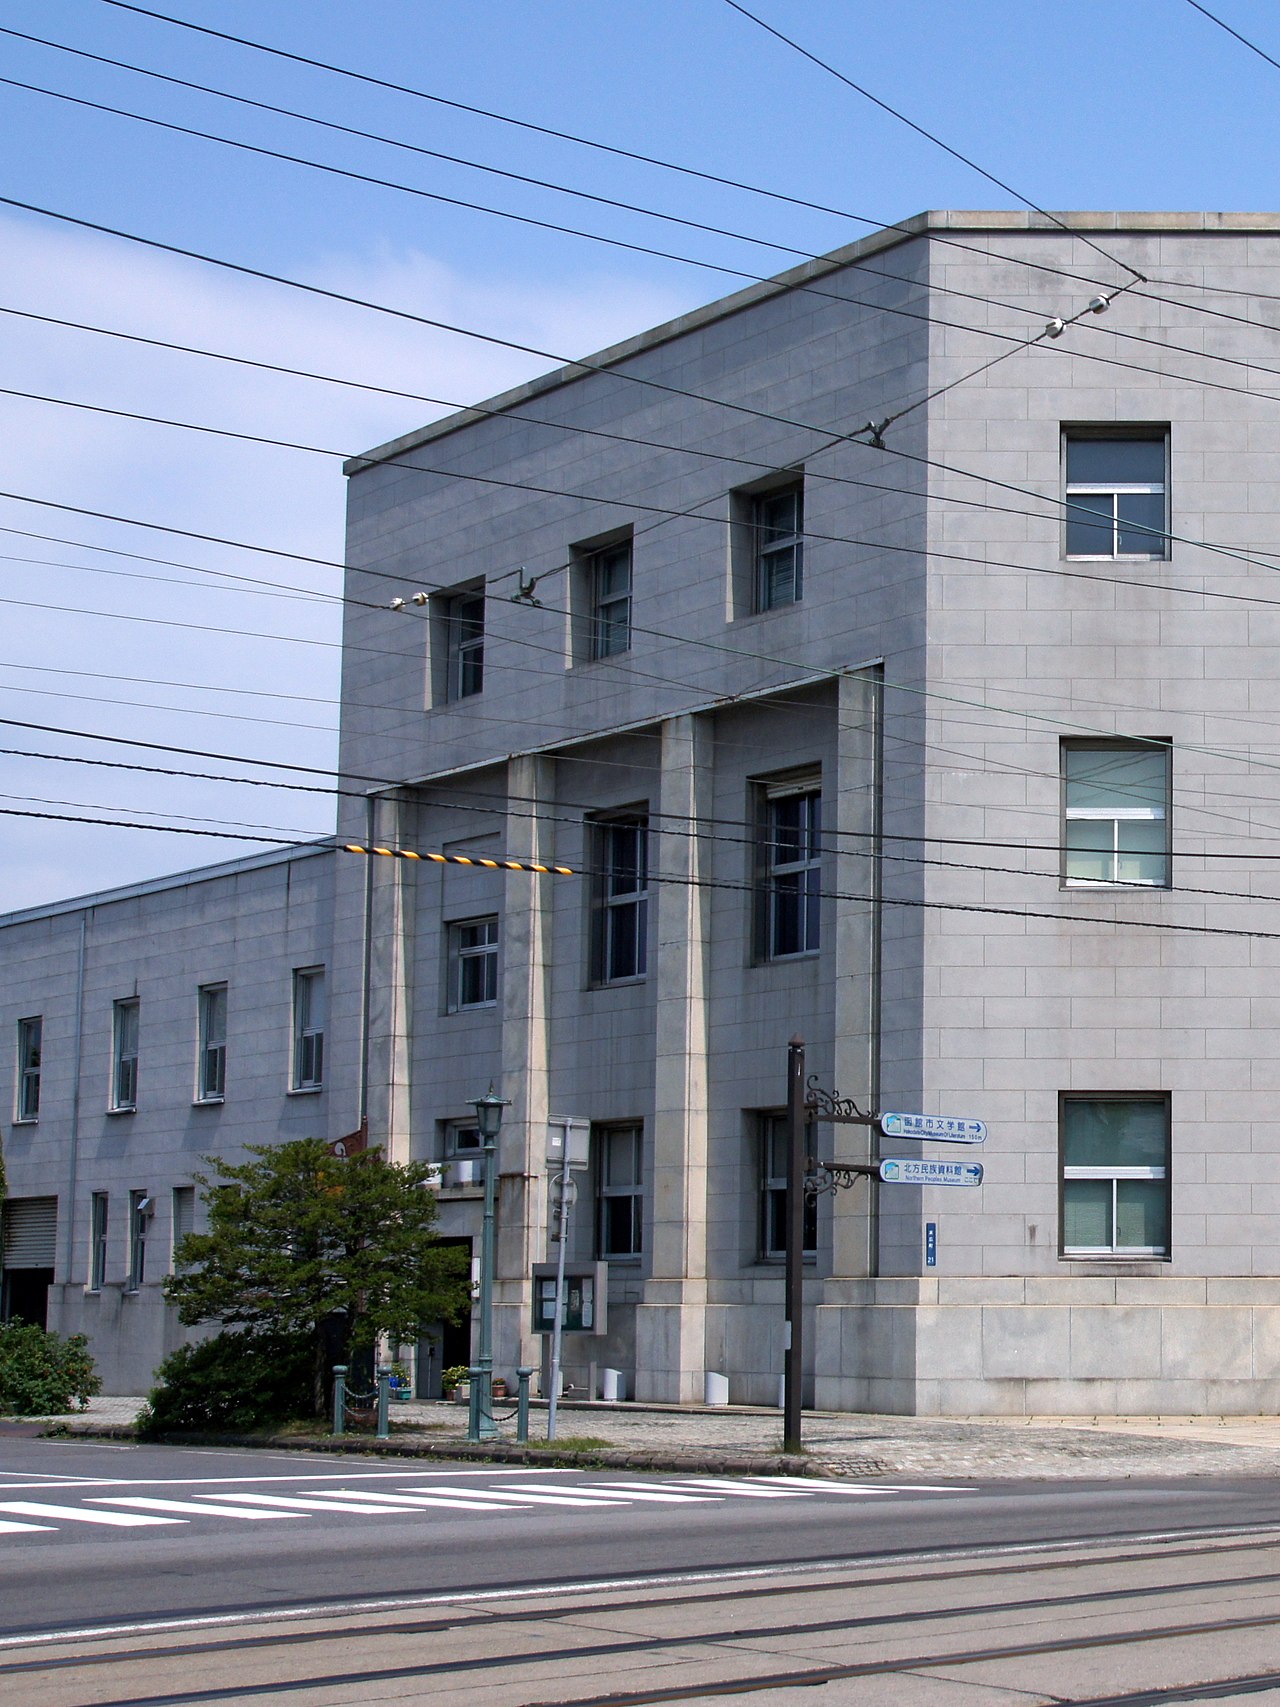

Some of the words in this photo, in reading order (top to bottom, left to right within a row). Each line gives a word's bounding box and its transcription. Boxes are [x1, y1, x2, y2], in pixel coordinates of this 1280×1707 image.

[904, 1163, 962, 1175] 北方民族資料館
